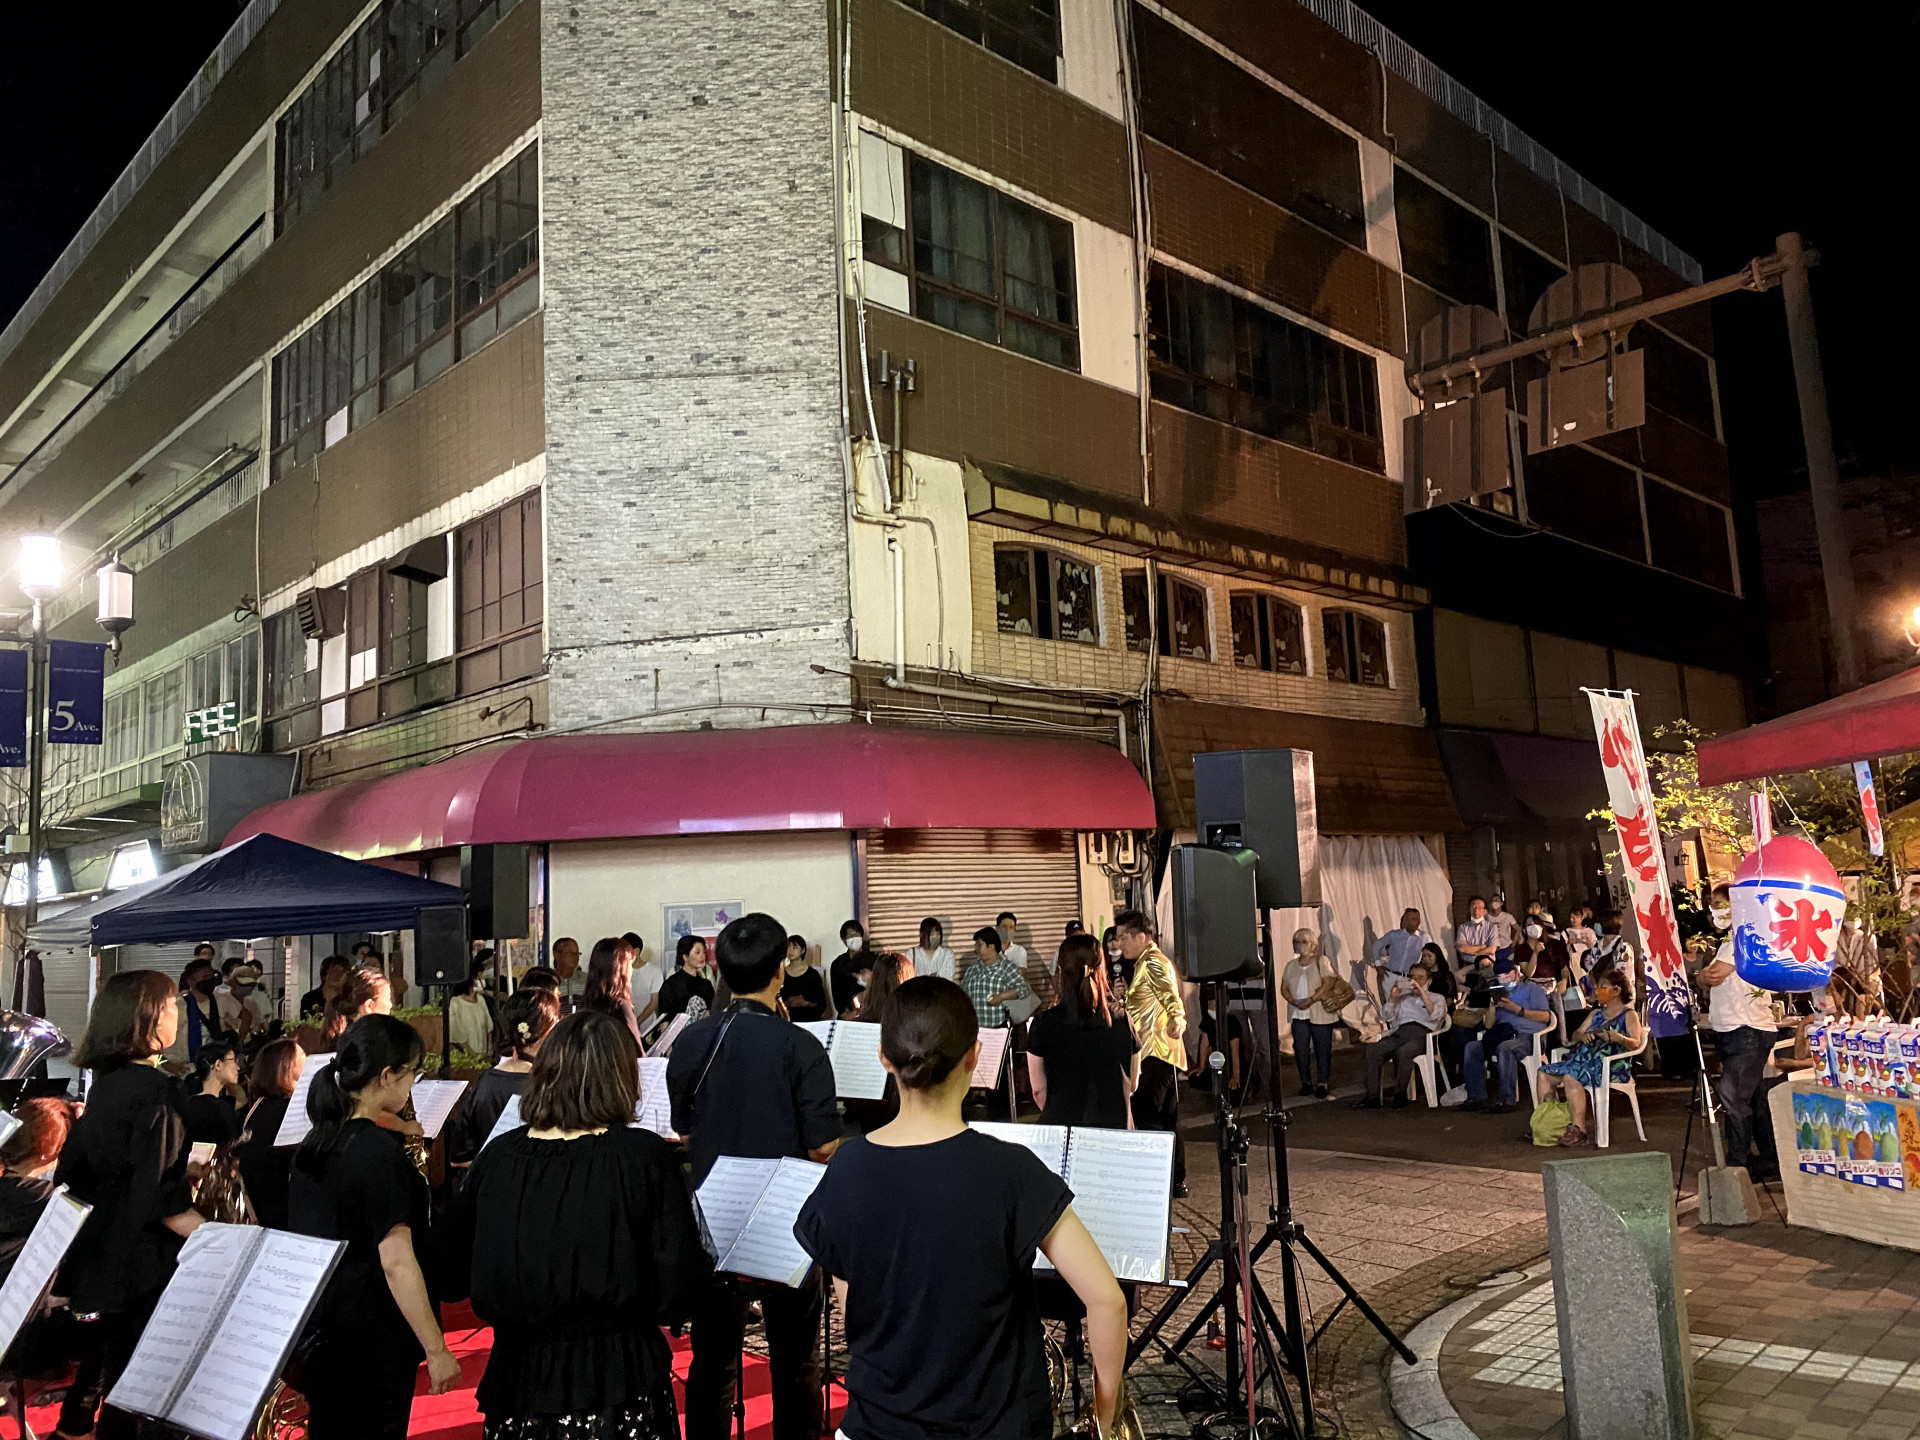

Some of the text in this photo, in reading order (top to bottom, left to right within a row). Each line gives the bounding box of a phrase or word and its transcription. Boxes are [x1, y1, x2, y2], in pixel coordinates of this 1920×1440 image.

[51, 699, 99, 731] 5 Ave.
[184, 701, 237, 743] FEE
[1768, 898, 1833, 963] 氷
